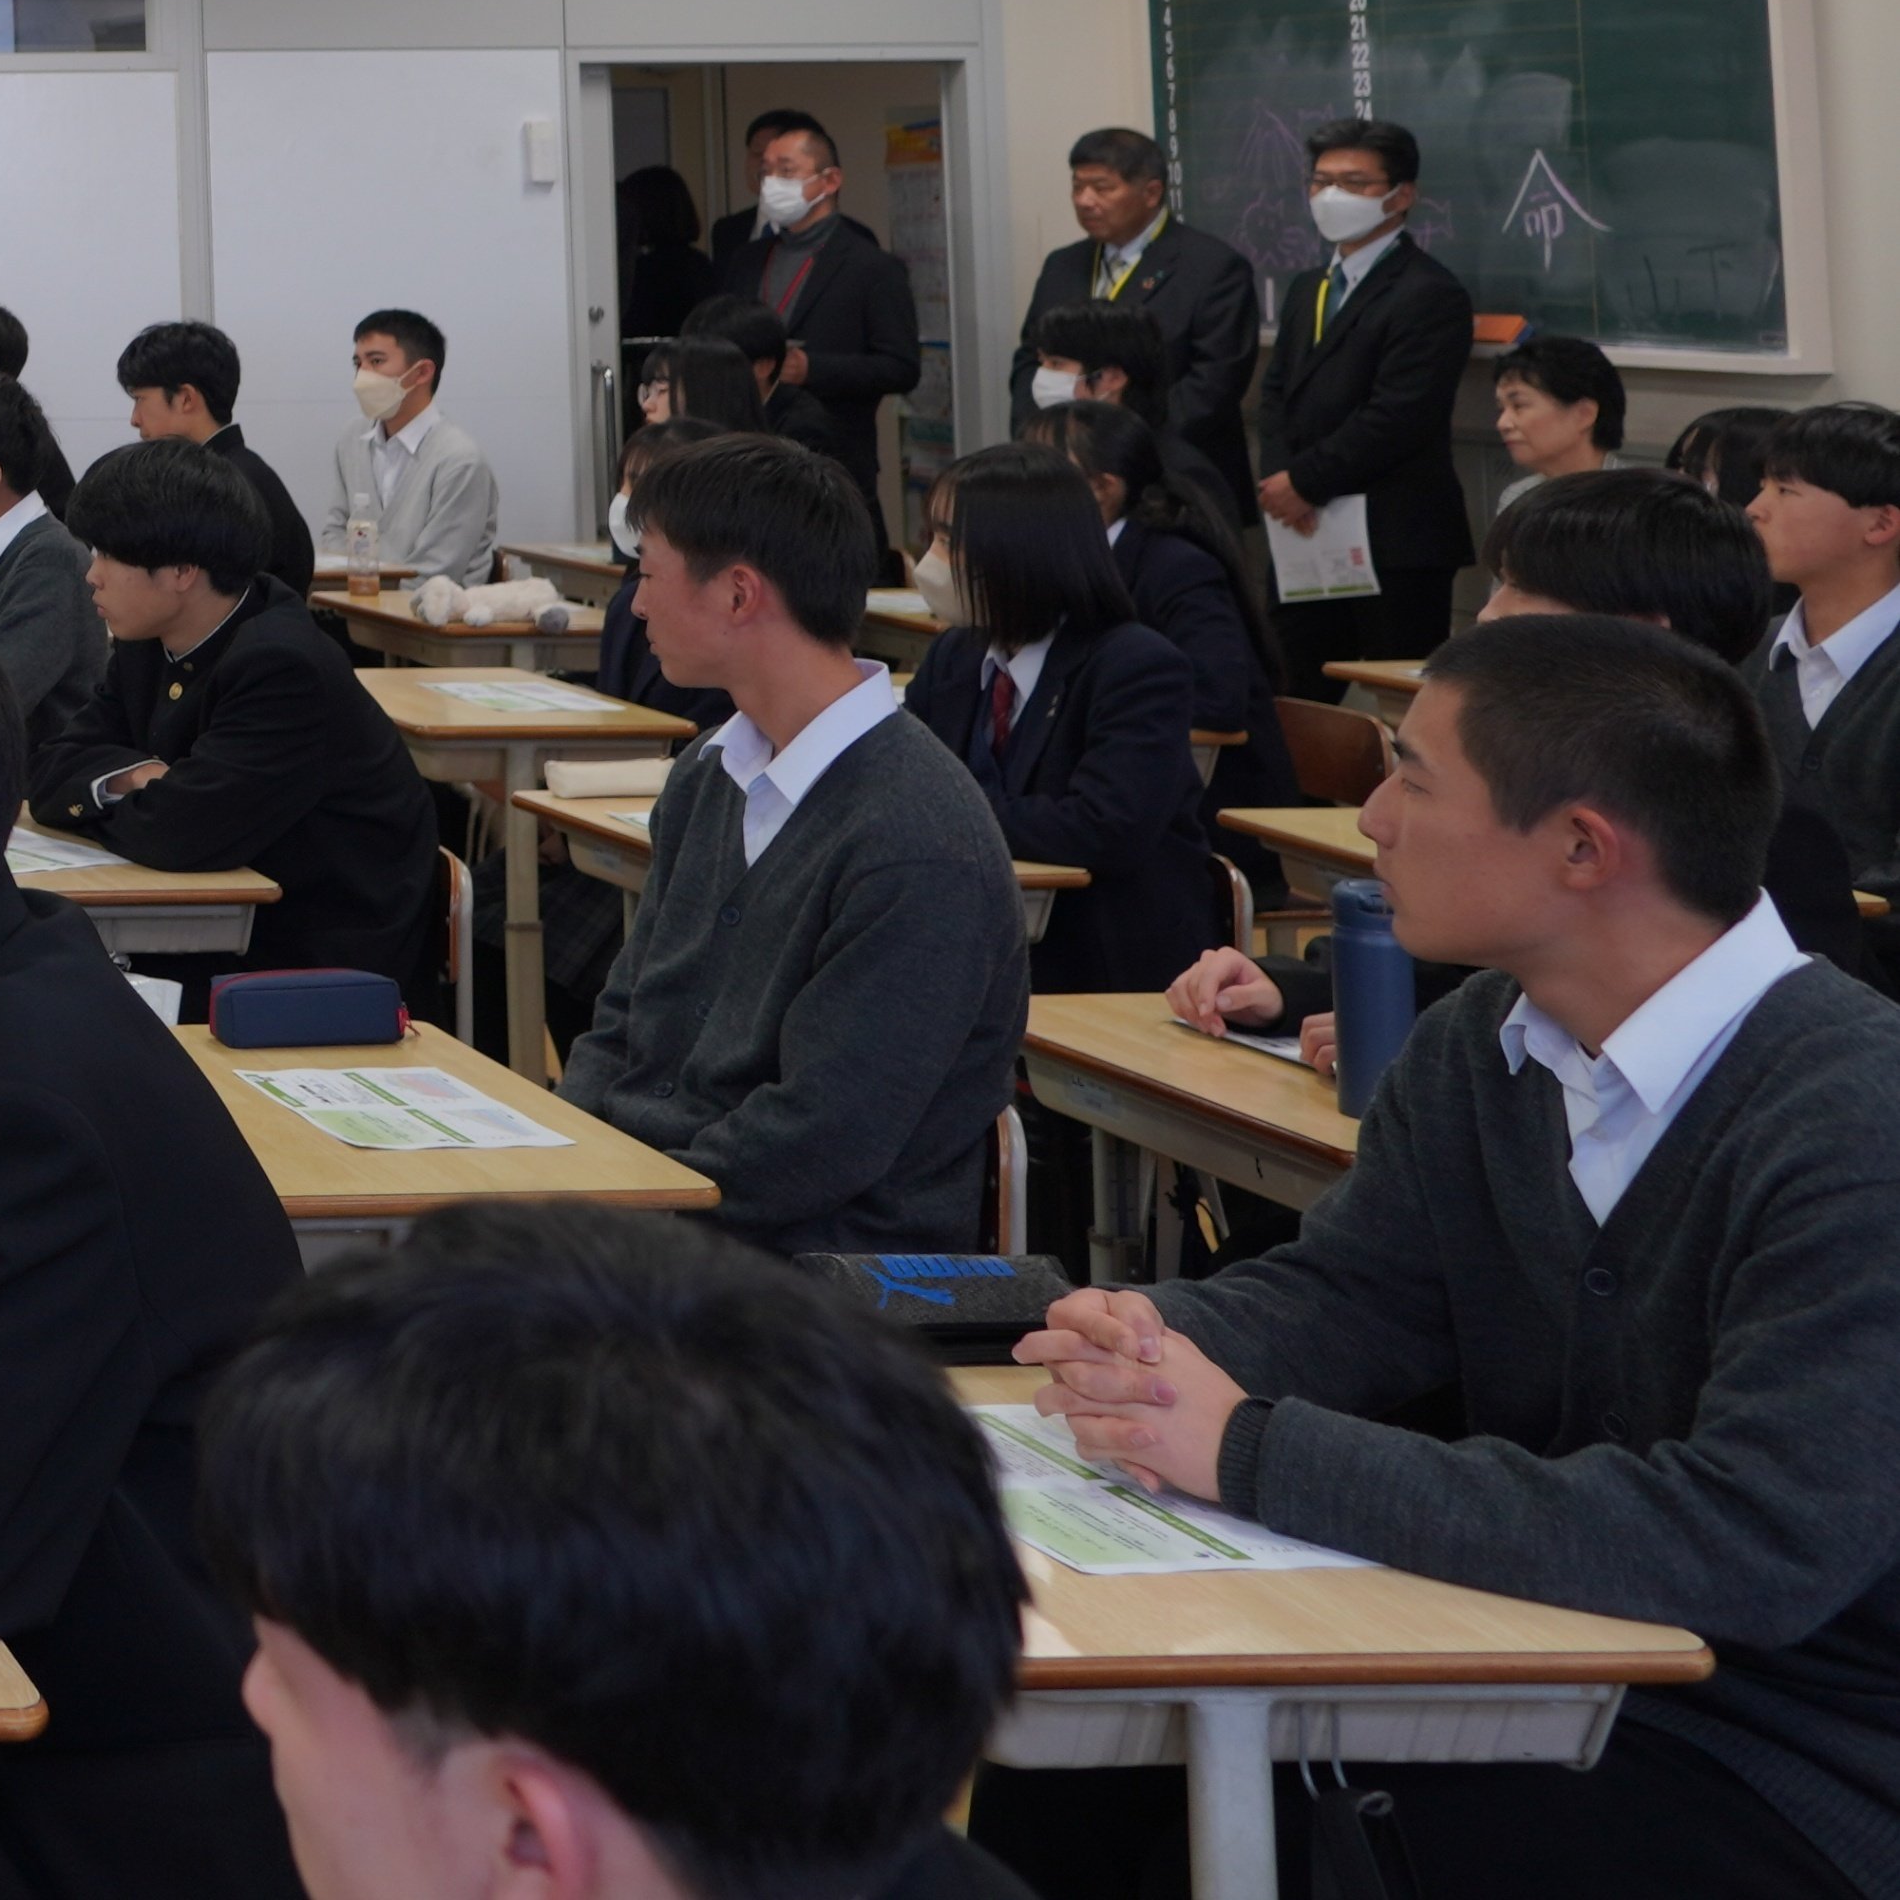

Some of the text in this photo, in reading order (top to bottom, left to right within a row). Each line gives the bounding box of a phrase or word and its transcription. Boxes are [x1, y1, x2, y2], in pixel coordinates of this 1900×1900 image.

[1163, 6, 1172, 28] 4
[1350, 15, 1367, 40] 21
[1165, 31, 1174, 54] 5
[1351, 43, 1369, 68] 22
[1167, 82, 1176, 105] 7
[1353, 70, 1371, 97] 23
[1168, 109, 1178, 132] 8
[1169, 135, 1179, 158] 9
